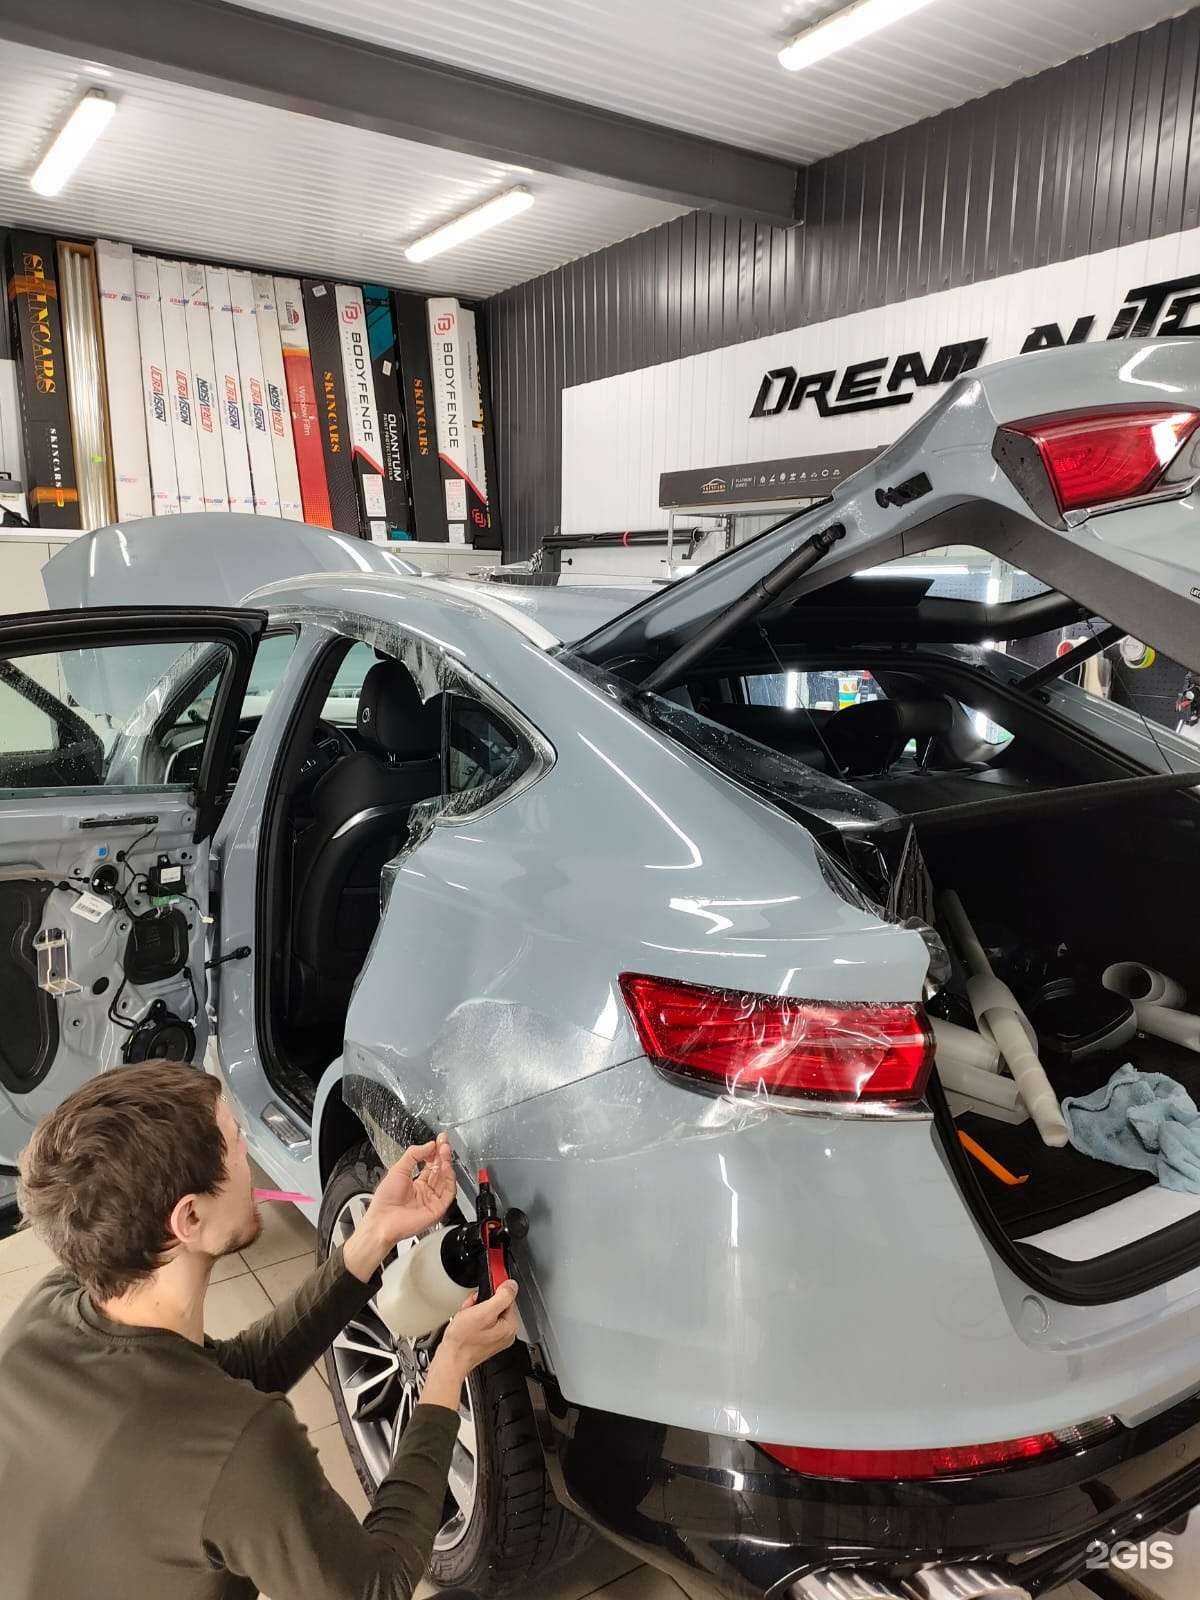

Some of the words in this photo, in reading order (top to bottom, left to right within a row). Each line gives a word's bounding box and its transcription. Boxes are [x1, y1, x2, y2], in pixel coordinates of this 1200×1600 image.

[323, 371, 341, 453] SKINCARS
[351, 332, 374, 443] BODYFENCE
[413, 378, 429, 456] SKINCARS
[443, 342, 459, 448] BODYFENCE
[749, 337, 988, 418] DREAM
[49, 427, 63, 488] SKINCARS
[387, 413, 402, 482] QUANTUM
